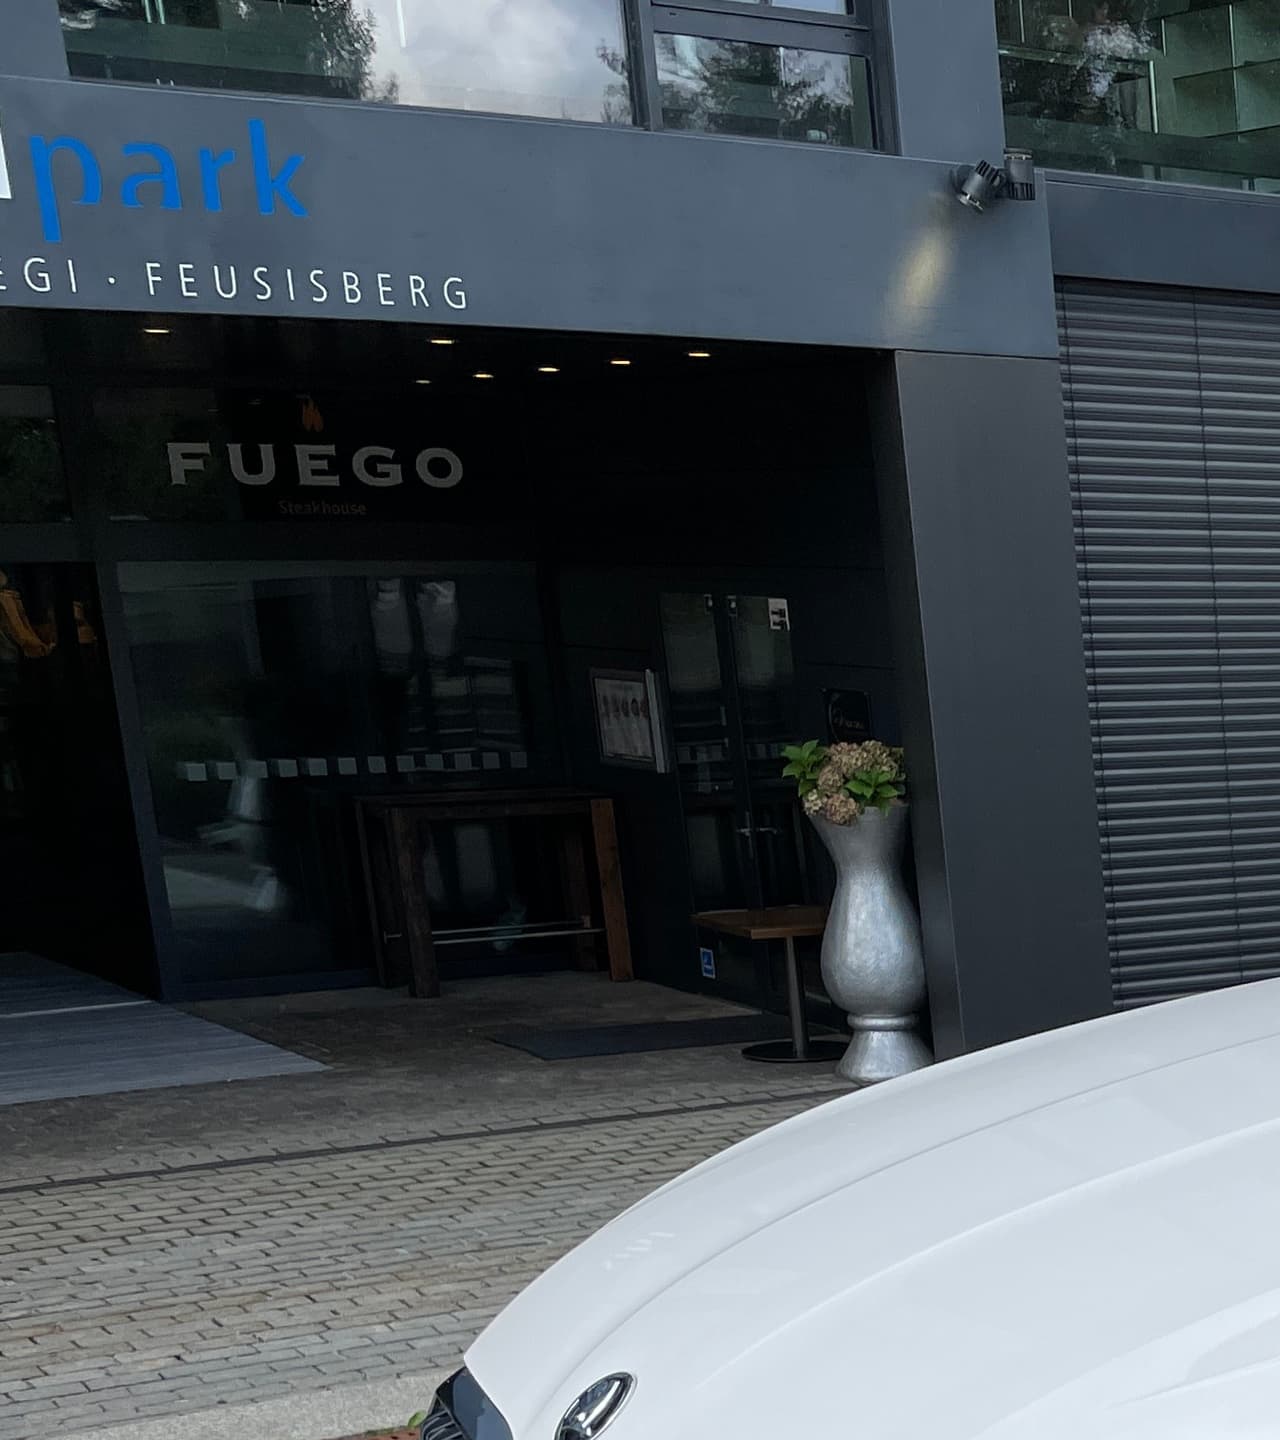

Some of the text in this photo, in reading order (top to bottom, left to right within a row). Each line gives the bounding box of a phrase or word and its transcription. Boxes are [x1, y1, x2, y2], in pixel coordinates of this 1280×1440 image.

[145, 262, 467, 309] FEUSISBERG
[166, 441, 464, 488] FUEGO
[279, 500, 367, 516] Steakhouse
